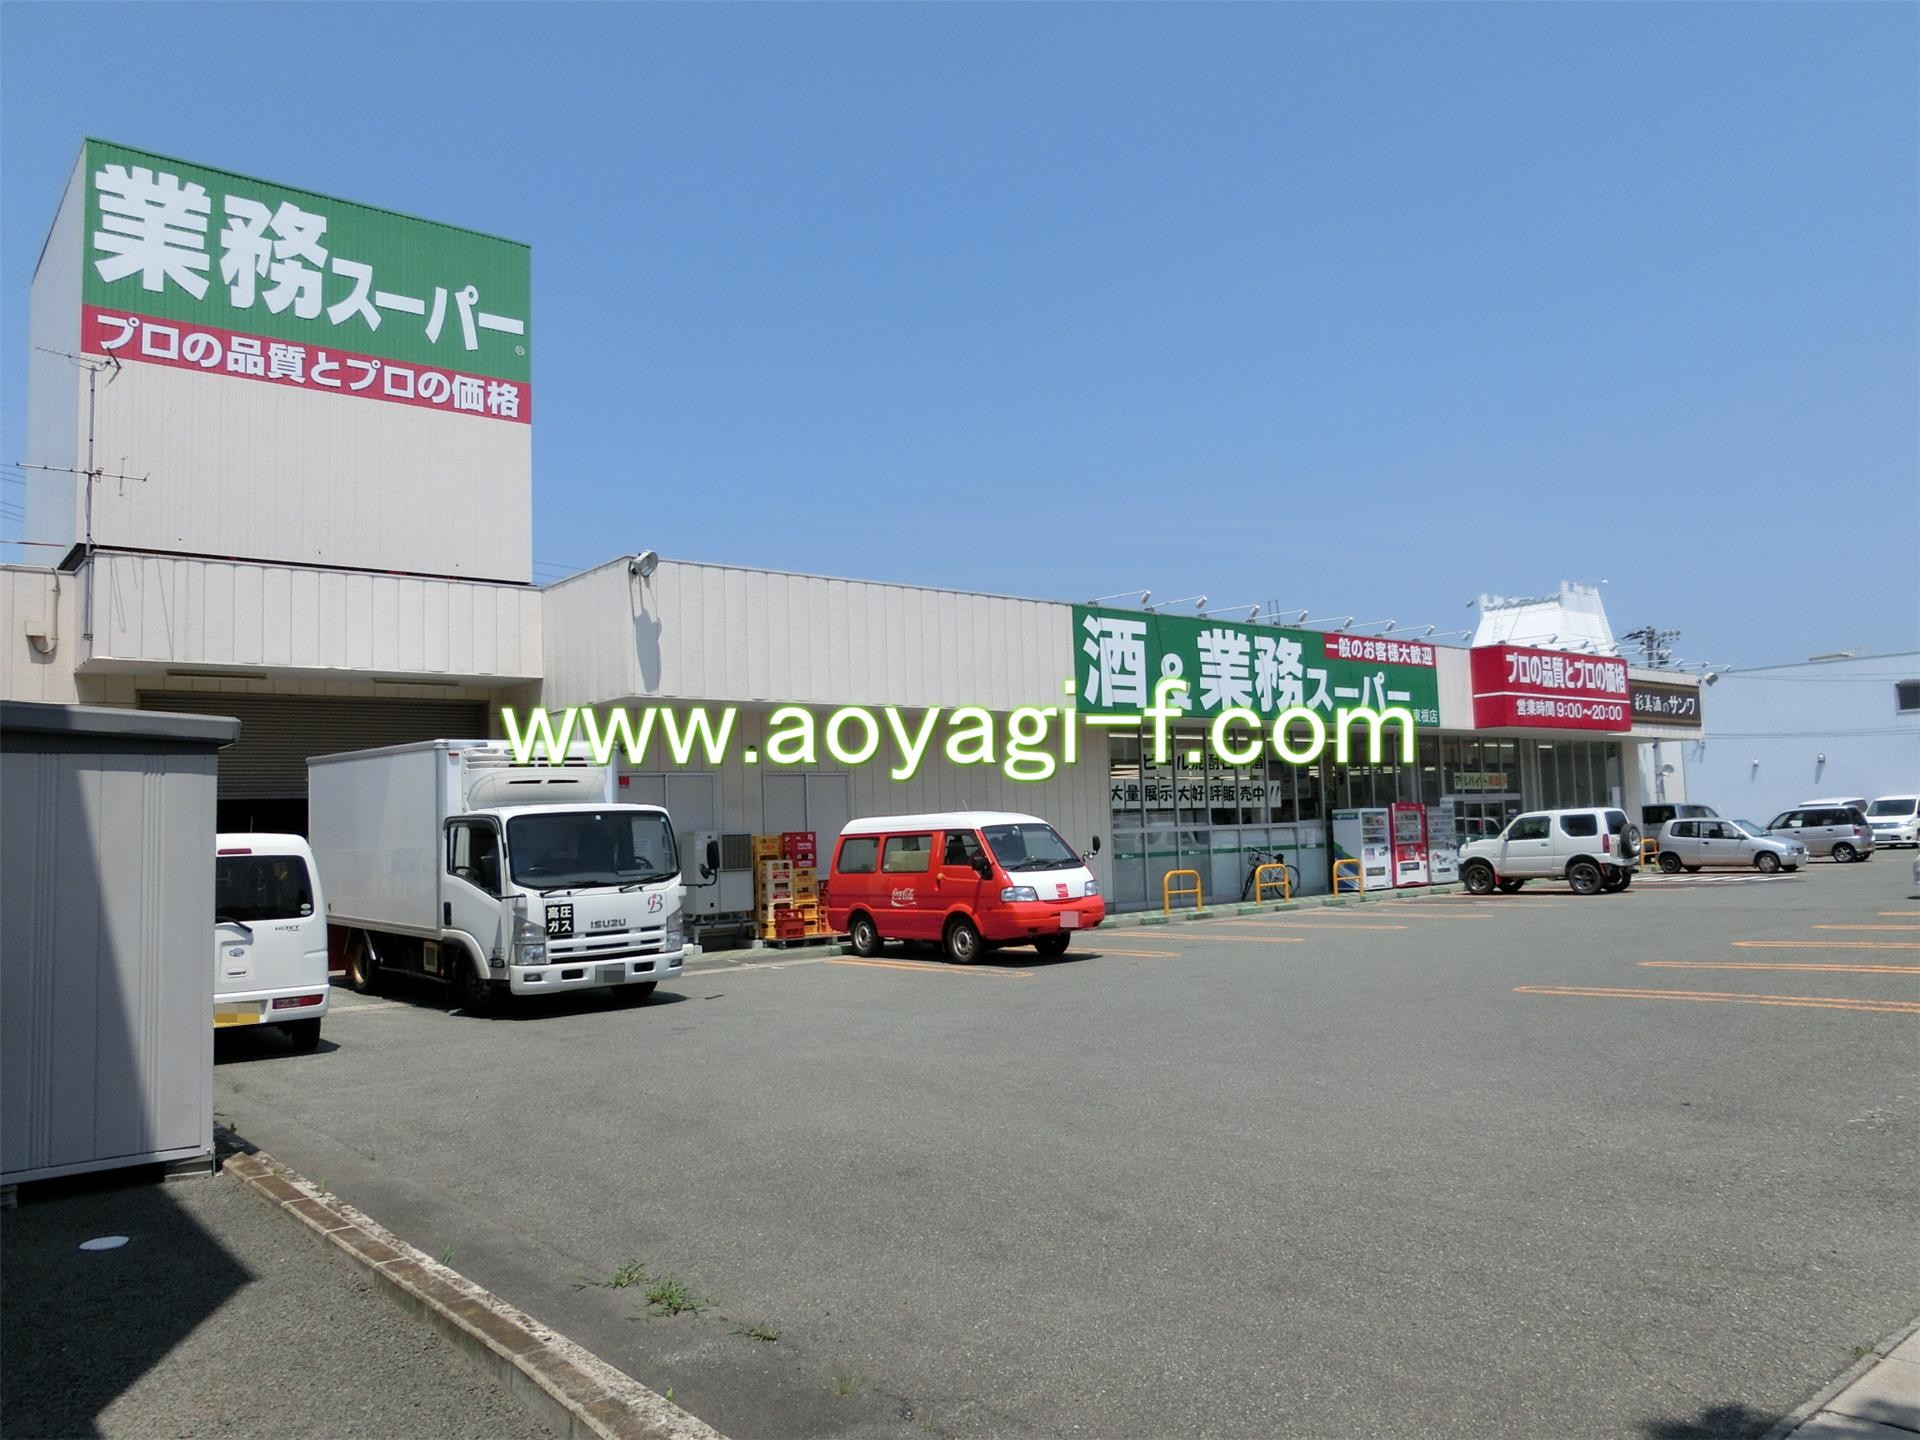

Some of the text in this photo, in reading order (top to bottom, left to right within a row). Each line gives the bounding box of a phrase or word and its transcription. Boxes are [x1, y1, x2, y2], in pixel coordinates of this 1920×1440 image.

[94, 164, 525, 351] 業務スーパー
[97, 313, 520, 419] プロの品質とプロの価格
[1325, 636, 1434, 666] 一般のお客様大歓迎
[1506, 651, 1626, 695] プロの品質とプロの価格
[1516, 698, 1555, 717] 営業時間
[547, 906, 572, 919] 高圧
[590, 919, 626, 929] ISUZU
[548, 921, 571, 933] ガス
